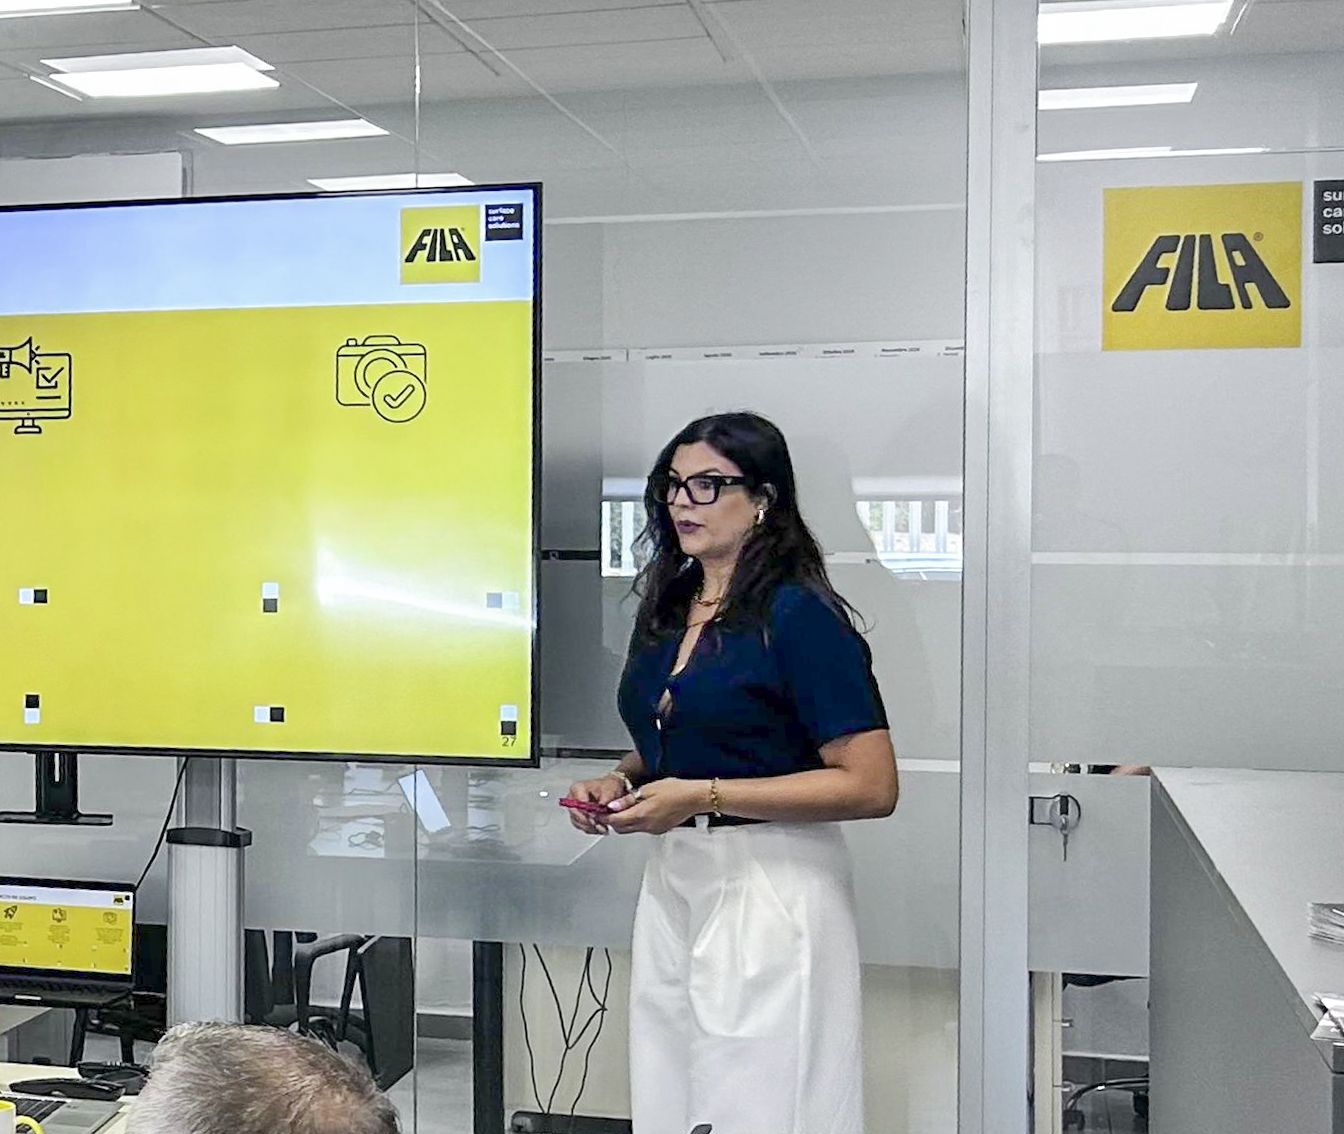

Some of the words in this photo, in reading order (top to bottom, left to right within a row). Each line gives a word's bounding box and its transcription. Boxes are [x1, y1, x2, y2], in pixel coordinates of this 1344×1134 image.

[1322, 191, 1344, 201] su
[1322, 207, 1344, 218] ca
[405, 228, 476, 262] FILA
[1112, 233, 1291, 312] FILA
[502, 736, 517, 748] 27
